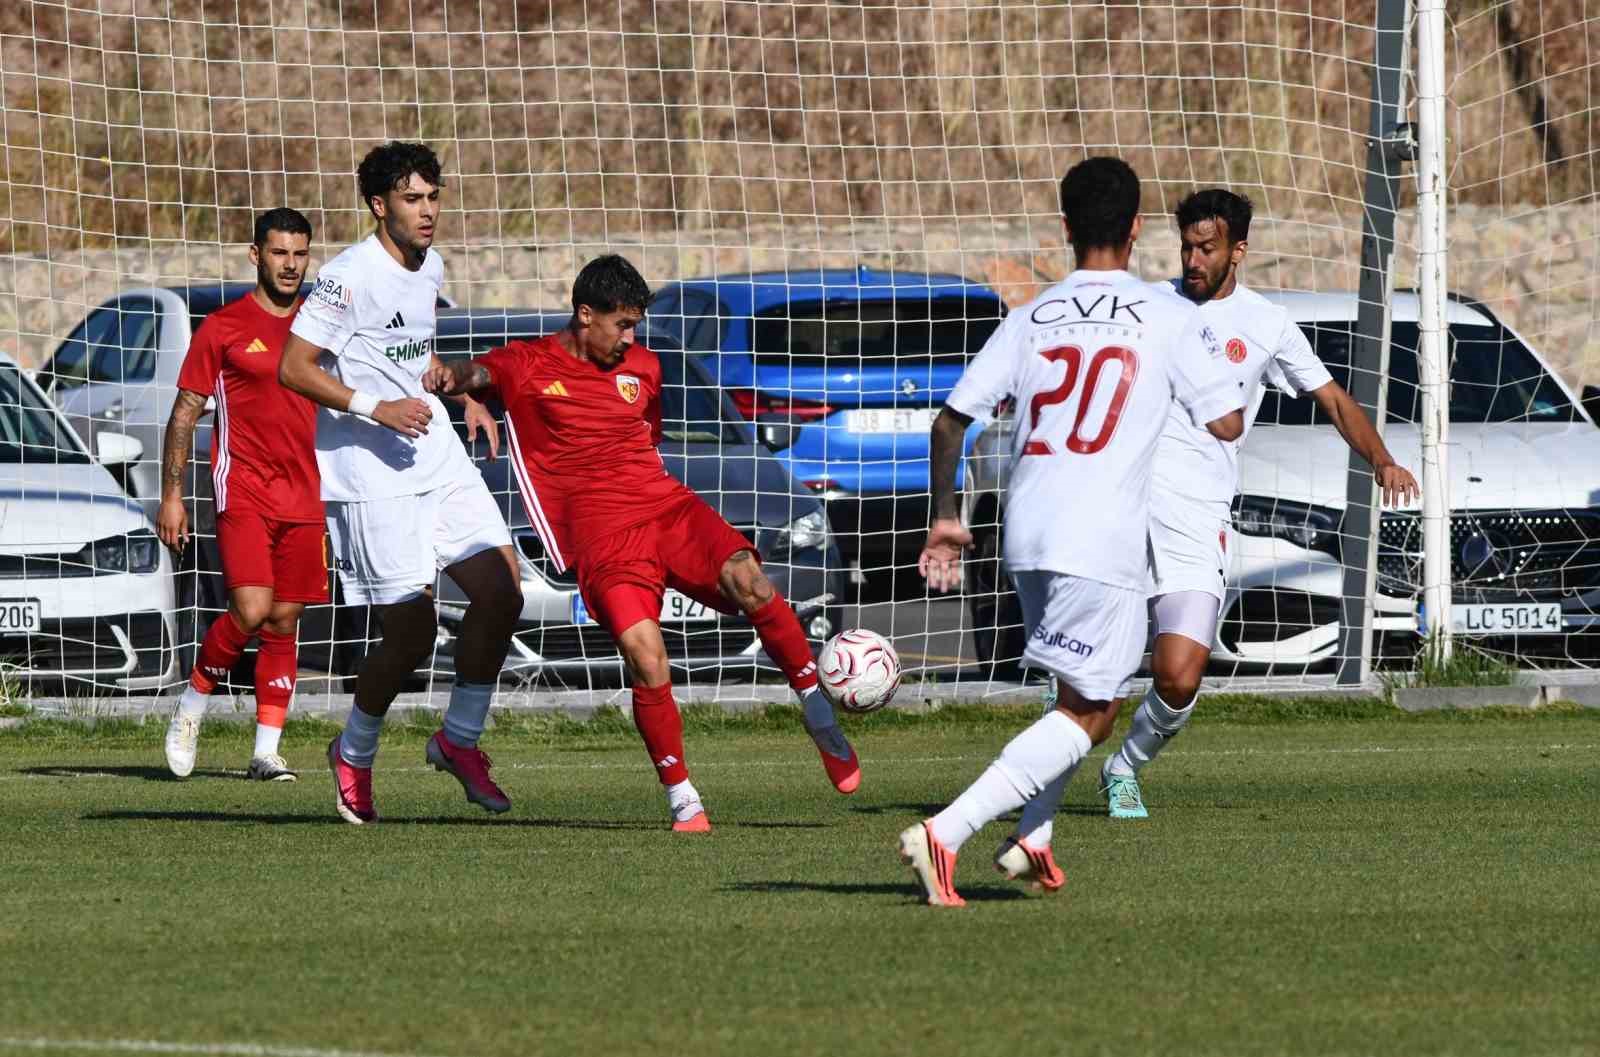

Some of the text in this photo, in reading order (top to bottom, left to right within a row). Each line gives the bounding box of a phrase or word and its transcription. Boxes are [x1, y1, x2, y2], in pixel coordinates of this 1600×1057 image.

[1030, 294, 1147, 324] CVK
[1023, 344, 1139, 455] 20
[0, 606, 34, 628] 206
[1466, 607, 1557, 630] LC 5014
[1032, 624, 1093, 656] Sultan
